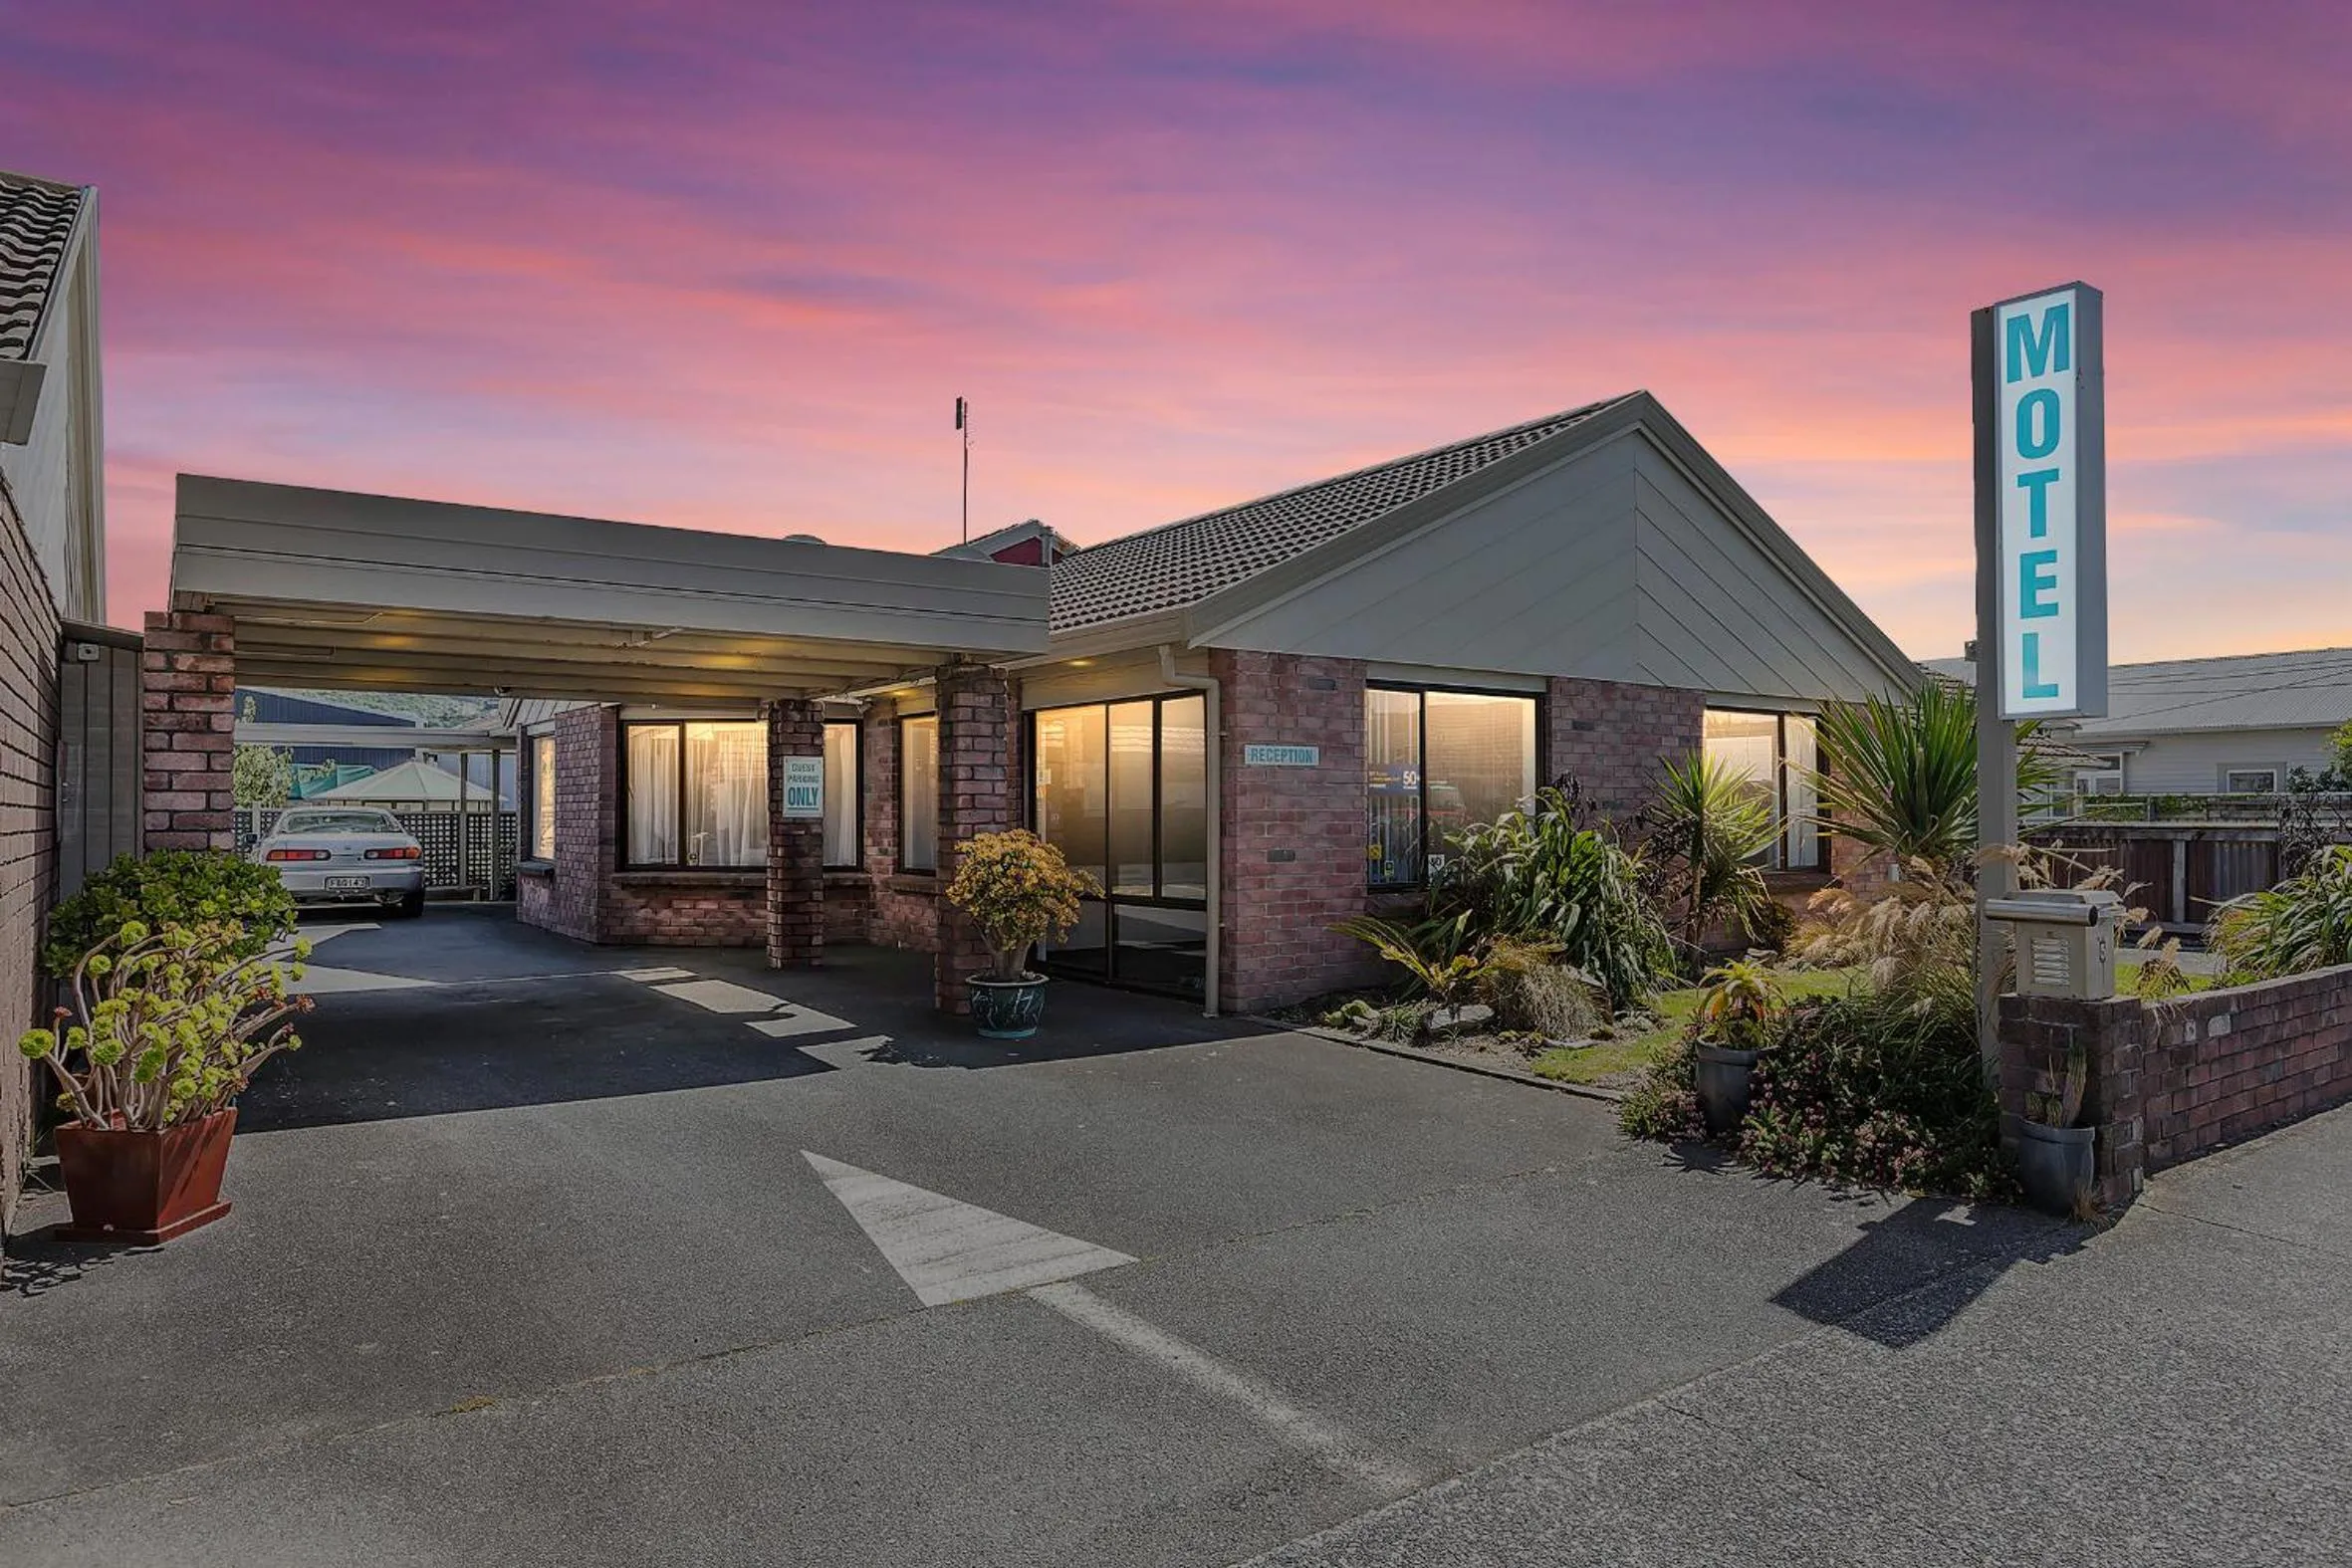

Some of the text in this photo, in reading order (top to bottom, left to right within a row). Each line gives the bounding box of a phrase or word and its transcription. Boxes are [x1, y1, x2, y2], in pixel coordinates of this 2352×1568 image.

[2006, 303, 2070, 699] MOTEL
[1251, 748, 1313, 764] RECEPTION
[792, 763, 816, 773] GUEST
[788, 786, 820, 806] ONLY
